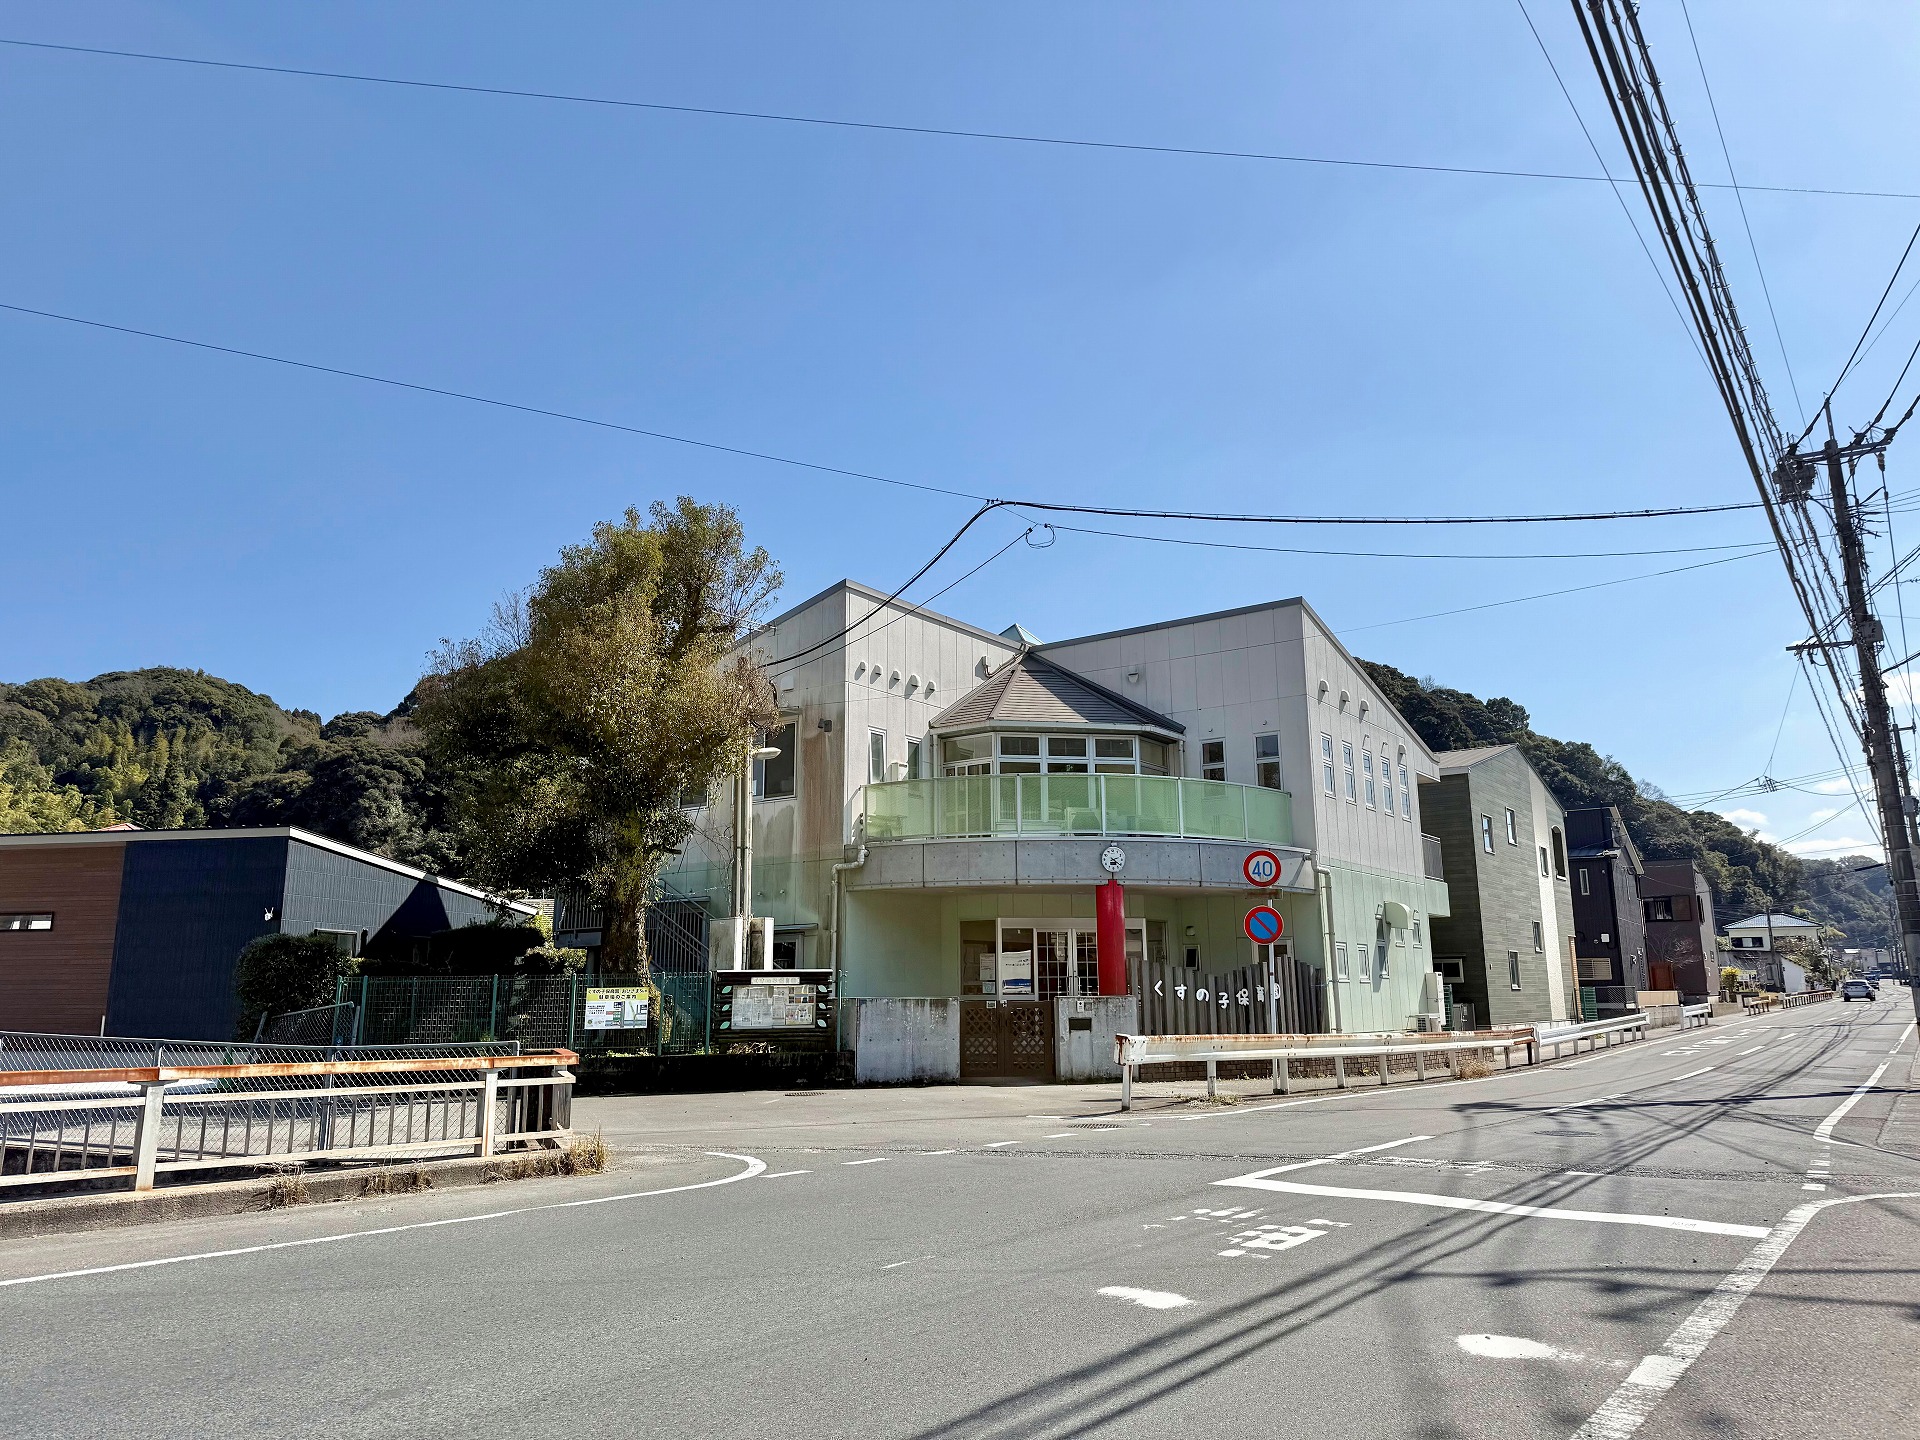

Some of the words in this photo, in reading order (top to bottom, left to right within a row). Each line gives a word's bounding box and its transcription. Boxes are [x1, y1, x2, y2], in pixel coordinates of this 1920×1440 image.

[1252, 860, 1272, 877] 40
[1153, 979, 1281, 1009] くすの子保育園
